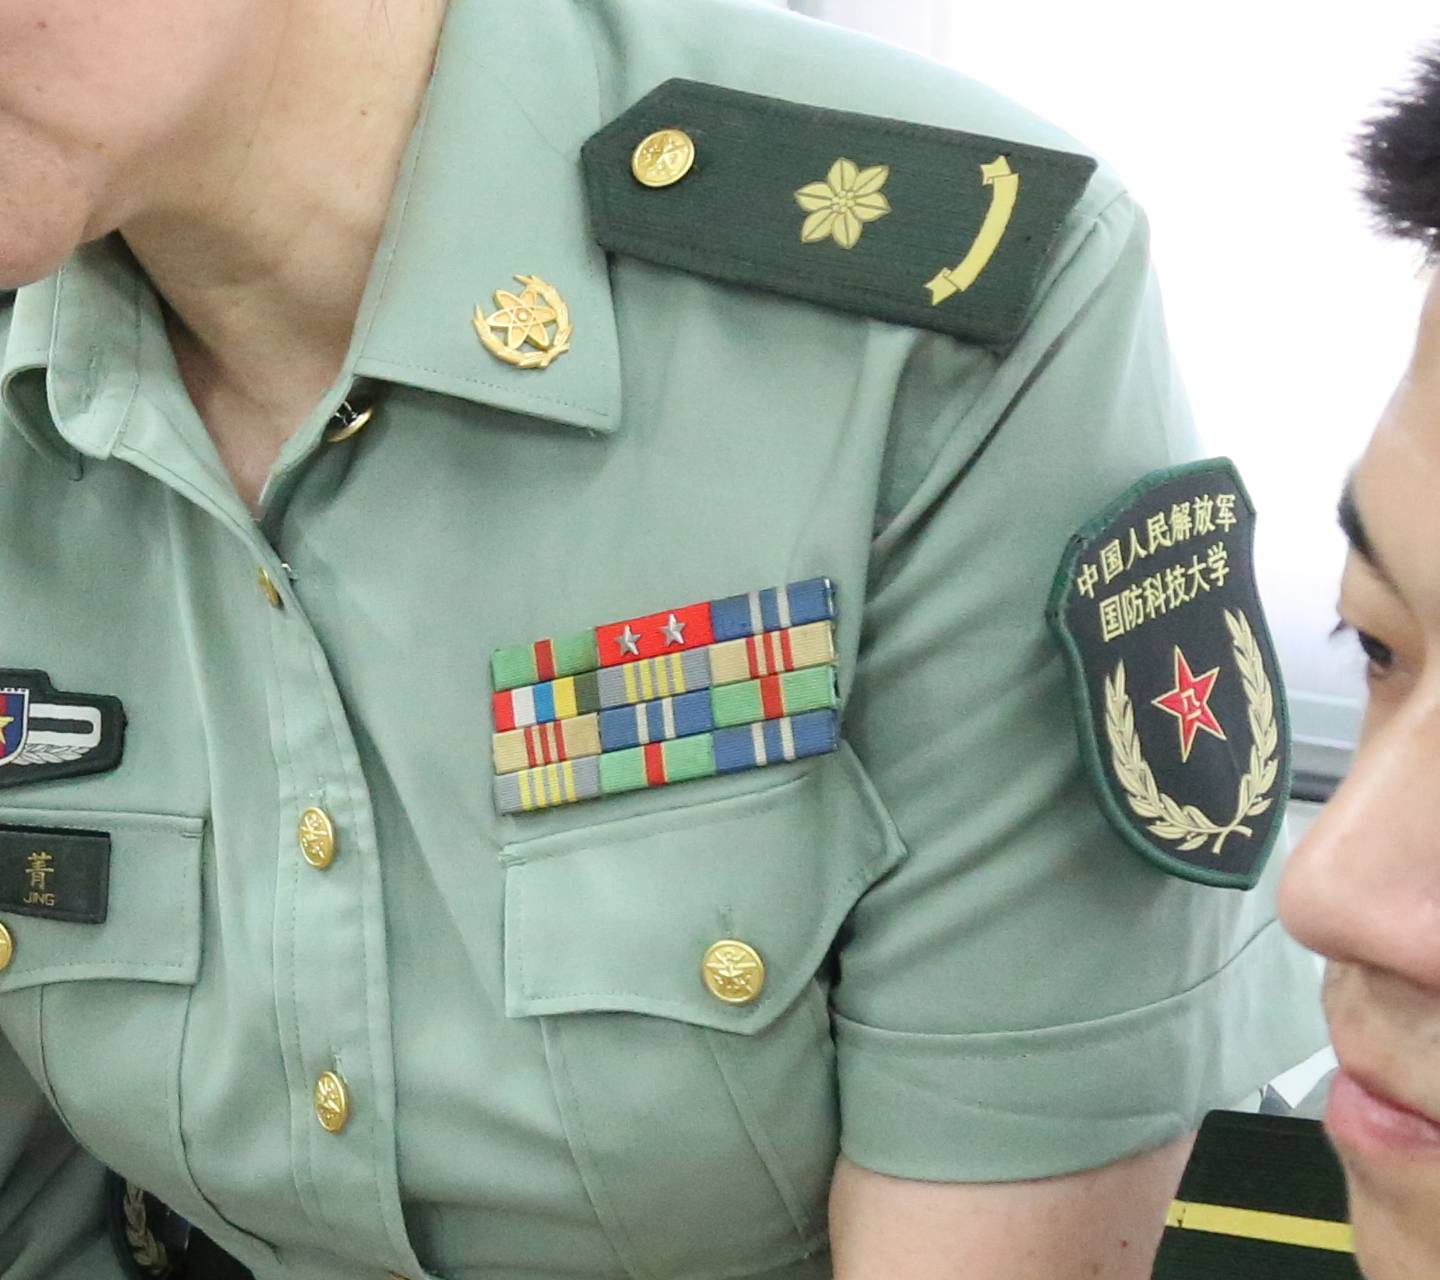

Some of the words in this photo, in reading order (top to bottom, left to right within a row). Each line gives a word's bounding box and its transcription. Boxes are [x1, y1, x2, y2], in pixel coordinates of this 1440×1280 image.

[1077, 493, 1237, 600] 中国人民解放军
[1099, 542, 1230, 643] 国防科技大学
[23, 892, 56, 907] JING
